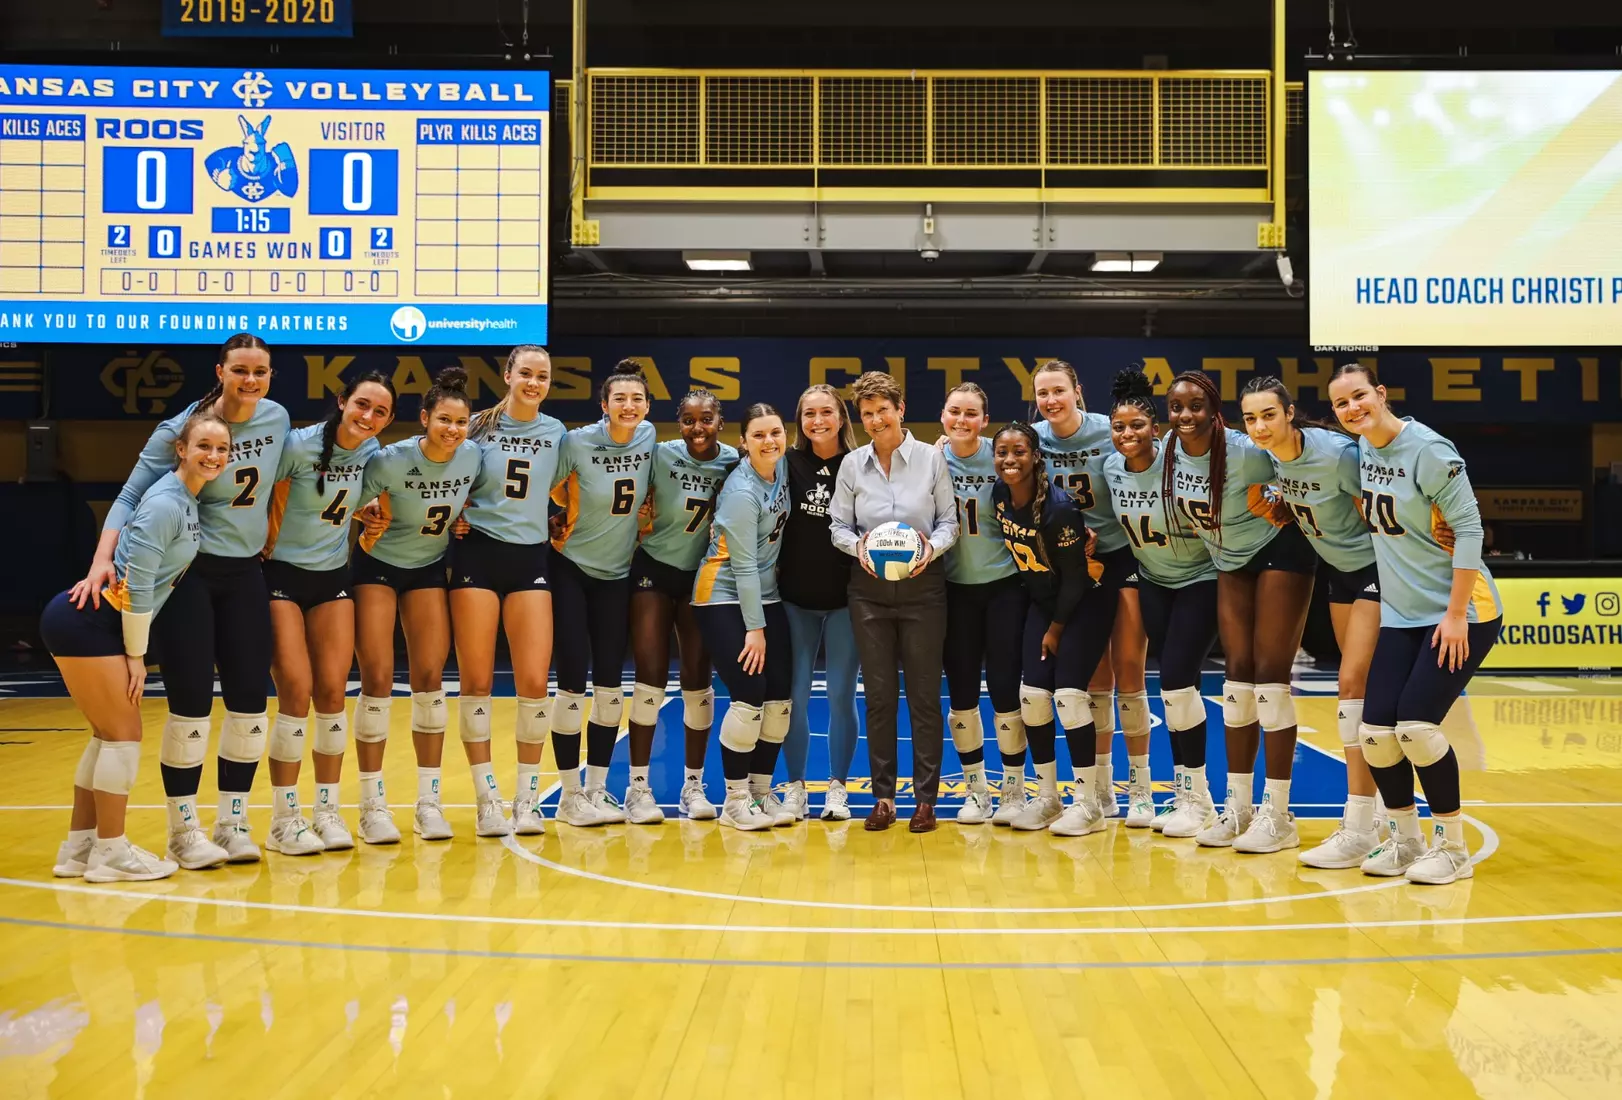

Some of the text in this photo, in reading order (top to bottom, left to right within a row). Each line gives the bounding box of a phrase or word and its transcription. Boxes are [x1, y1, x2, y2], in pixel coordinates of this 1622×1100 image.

[180, 0, 335, 23] 2019-2020
[0, 77, 114, 97] ANSAS
[132, 79, 220, 98] CITY
[285, 81, 533, 101] VOLLEYBALL
[3, 119, 81, 136] KILLS ACES
[95, 118, 204, 140] ROOS
[320, 121, 386, 141] VISITOR
[420, 124, 537, 141] PLYR KILLS ACES
[137, 150, 167, 210] 0
[342, 152, 372, 211] 0
[236, 207, 271, 232] 1:15
[113, 226, 126, 245] 2
[157, 229, 174, 256] 0
[327, 230, 345, 257] 0
[375, 228, 388, 247] 2
[100, 248, 137, 257] TIMEOUTS
[189, 241, 312, 259] GAMES WON
[364, 250, 400, 259] TIMEOUTS
[110, 256, 127, 264] LEFT
[373, 258, 389, 266] LEFT
[1356, 277, 1622, 304] HEAD COACH CHRISTI P
[0, 313, 348, 331] ANK YOU TO OUR FOUNDING PARTNERS
[303, 355, 1622, 402] KANSAS CITY ATHLETI
[231, 436, 274, 453] NSAS
[487, 435, 553, 448] KANSAS
[501, 444, 540, 455] CITY
[591, 451, 650, 465] KANSAS
[1040, 448, 1100, 460] KANSAS
[313, 463, 364, 473] KANSA
[606, 463, 641, 473] CITY
[1053, 459, 1087, 468] CITY
[1361, 461, 1406, 478] KANSAS
[327, 473, 360, 483] CITY
[404, 476, 471, 490] KANSAS
[504, 457, 532, 501] 5
[951, 475, 996, 483] NSAS
[1367, 473, 1393, 486] CITY
[230, 466, 261, 508] 2
[421, 488, 460, 499] CITY
[682, 482, 717, 493] CITY
[1112, 487, 1160, 499] KANSA
[1177, 482, 1210, 494] CITY
[1282, 485, 1307, 499] CITY
[610, 477, 636, 517] 6
[1120, 499, 1155, 508] CITY
[320, 488, 350, 528] 4
[683, 496, 710, 534] 7
[420, 504, 452, 537] 3
[1119, 513, 1169, 549] 14
[1495, 624, 1622, 645] KCROOSATH
